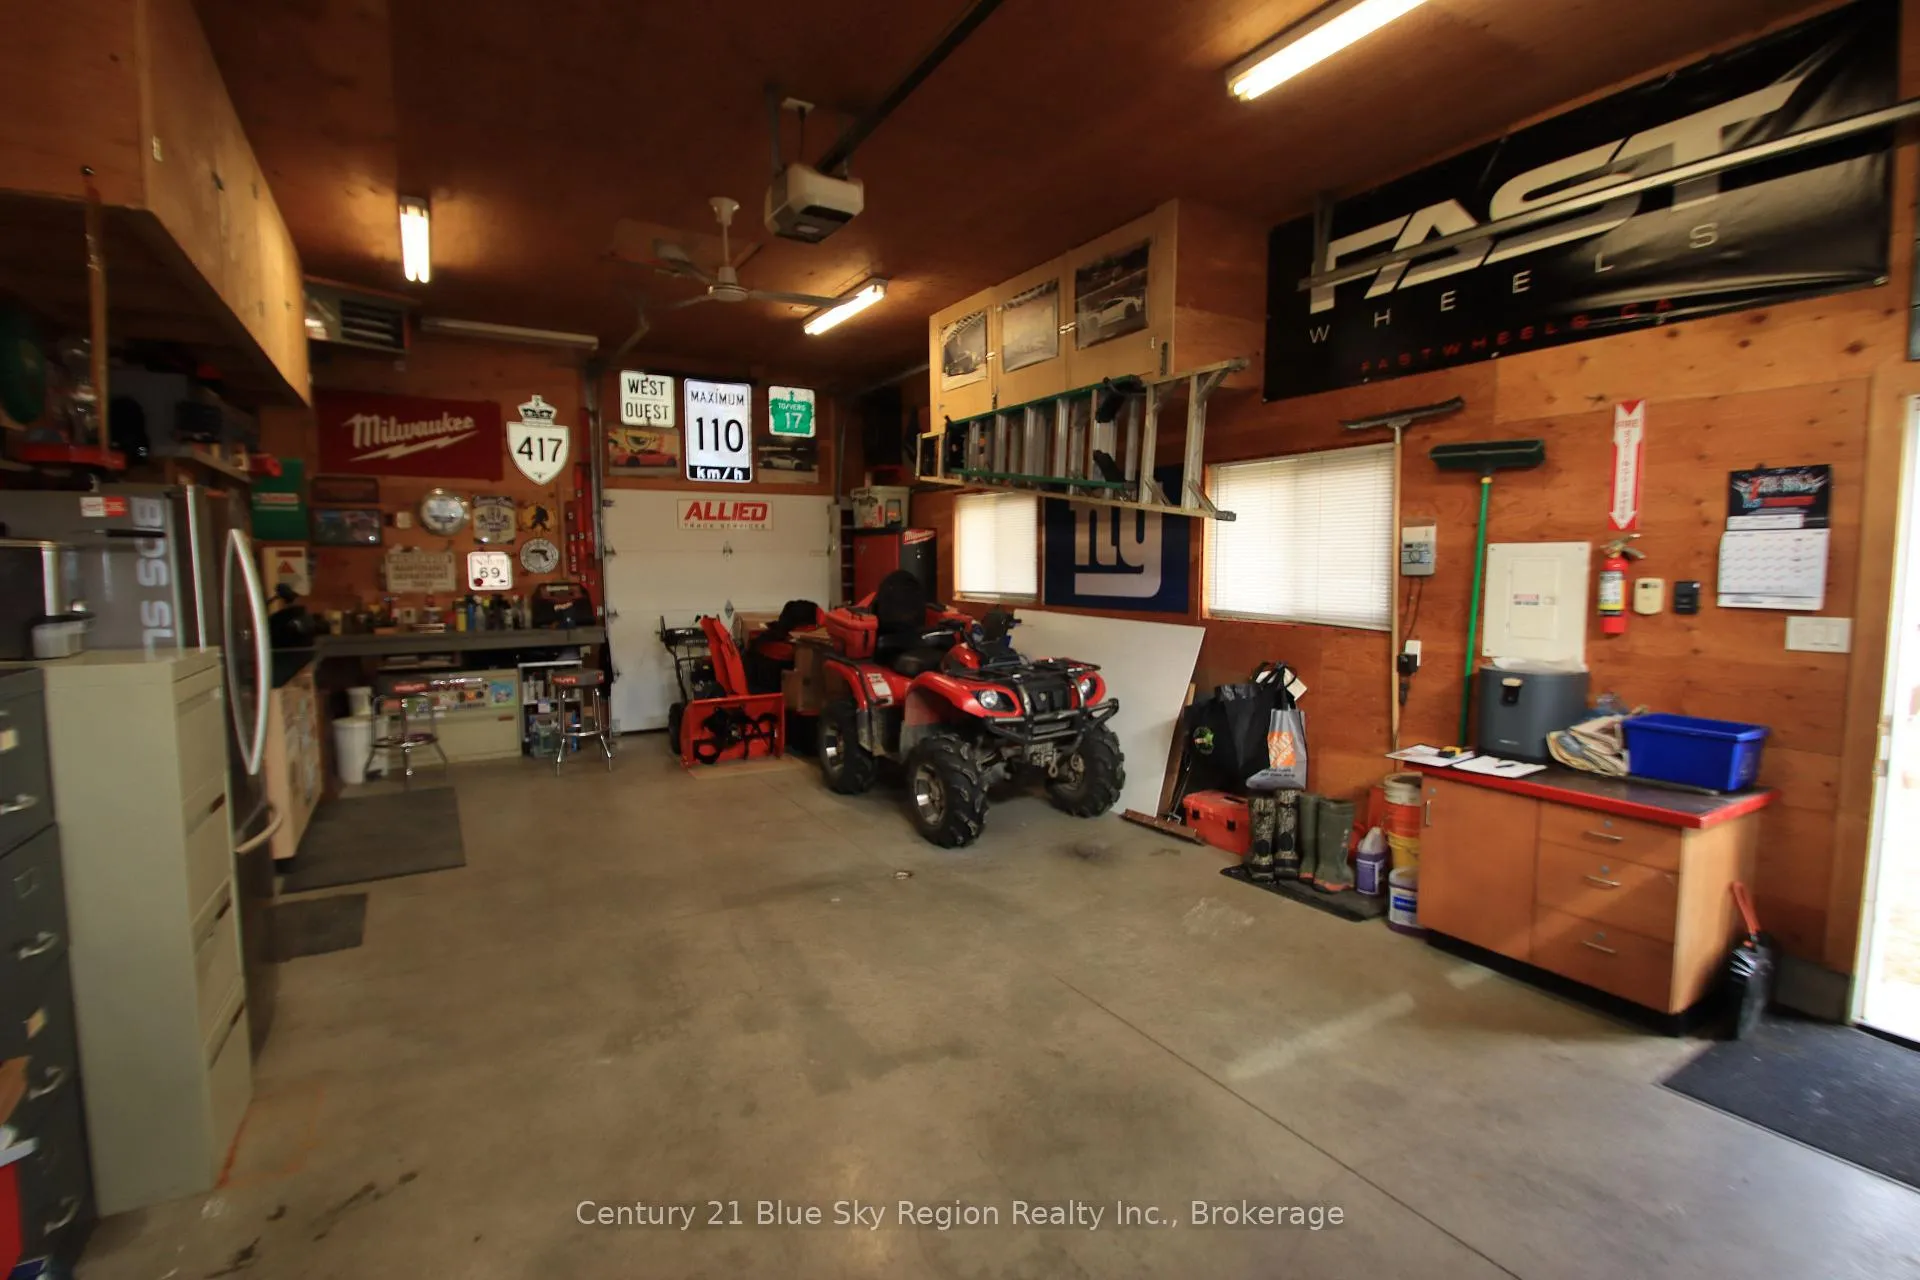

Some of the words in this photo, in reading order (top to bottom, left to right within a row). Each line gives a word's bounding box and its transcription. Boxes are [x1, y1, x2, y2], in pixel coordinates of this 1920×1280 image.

[1309, 78, 1804, 315] FAST
[1309, 223, 1719, 344] WHEELS
[1360, 298, 1674, 373] FASTWHEELSCA
[627, 377, 665, 397] WEST
[691, 390, 744, 406] MAXIMUM
[625, 402, 669, 420] OUEST
[785, 412, 803, 429] 17
[342, 411, 476, 449] Milwaukee
[696, 417, 744, 453] 110
[517, 435, 563, 462] 417
[696, 466, 744, 481] km/h
[684, 500, 768, 521] ALLIED
[480, 567, 500, 579] 69
